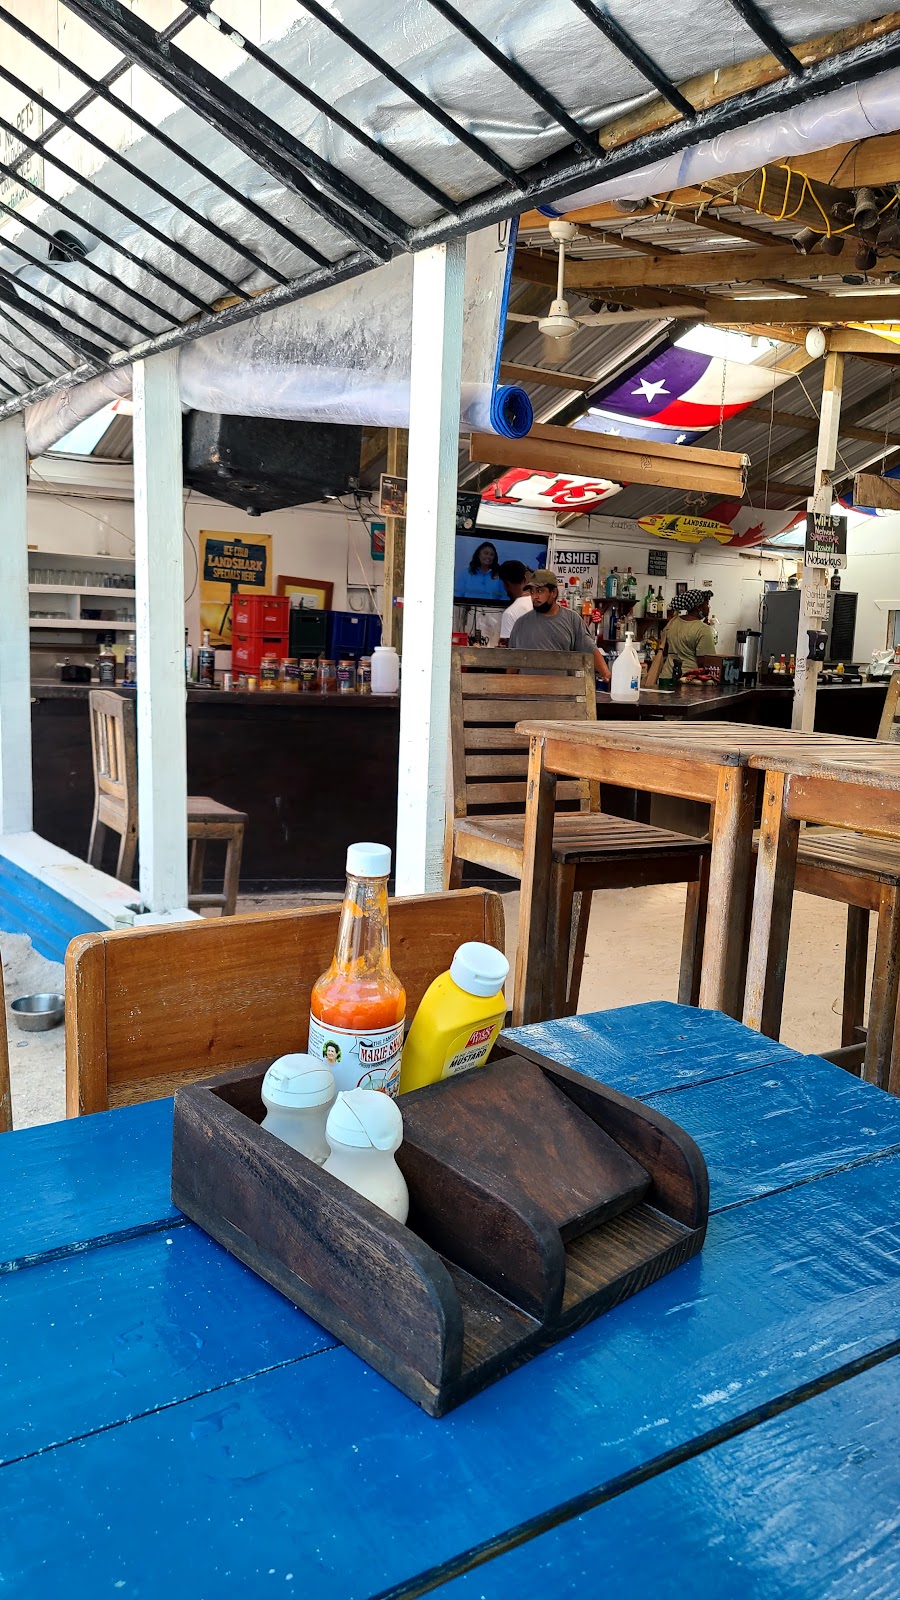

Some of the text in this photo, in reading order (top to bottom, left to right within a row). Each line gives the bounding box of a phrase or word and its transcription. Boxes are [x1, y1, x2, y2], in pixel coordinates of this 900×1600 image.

[17, 100, 33, 132] PETS
[683, 518, 720, 529] LANDSHARK
[223, 545, 249, 558] ICE COLD
[207, 554, 263, 572] LANDSHARK
[557, 566, 591, 575] WE ACCEPT
[213, 567, 257, 582] SPECIALS HERE
[360, 1045, 388, 1063] MARIE
[448, 1048, 488, 1069] MUSTARD
